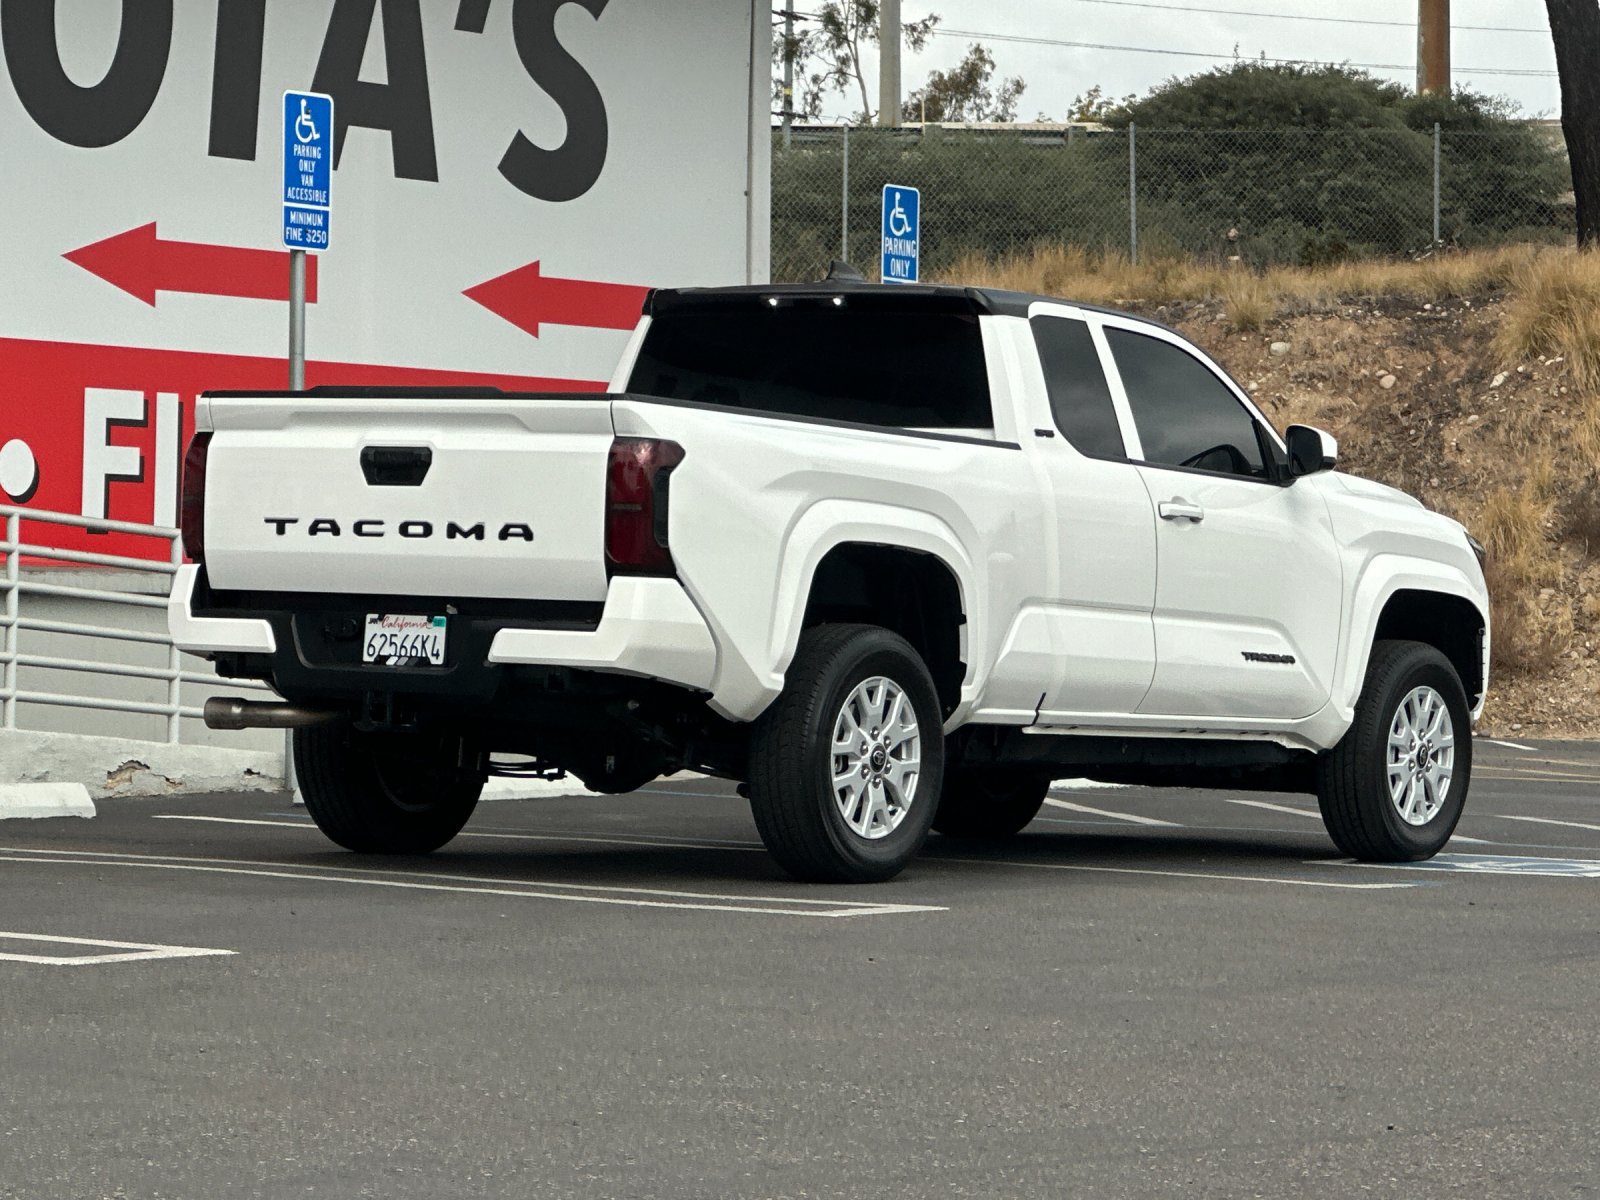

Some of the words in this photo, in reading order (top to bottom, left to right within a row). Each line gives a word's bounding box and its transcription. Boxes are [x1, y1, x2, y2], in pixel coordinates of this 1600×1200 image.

[293, 144, 321, 159] PARKING
[299, 159, 315, 172] ONLY
[301, 175, 313, 187] VAN
[287, 187, 326, 203] ACCESSIBLE
[290, 211, 323, 226] MINIMUM
[286, 227, 303, 241] FINE
[306, 230, 327, 244] $250
[885, 237, 916, 258] PARKING
[890, 258, 910, 277] ONLY
[81, 387, 203, 534] FI
[264, 517, 534, 541] TACOMA
[380, 616, 433, 632] California
[366, 633, 441, 660] 62566K4
